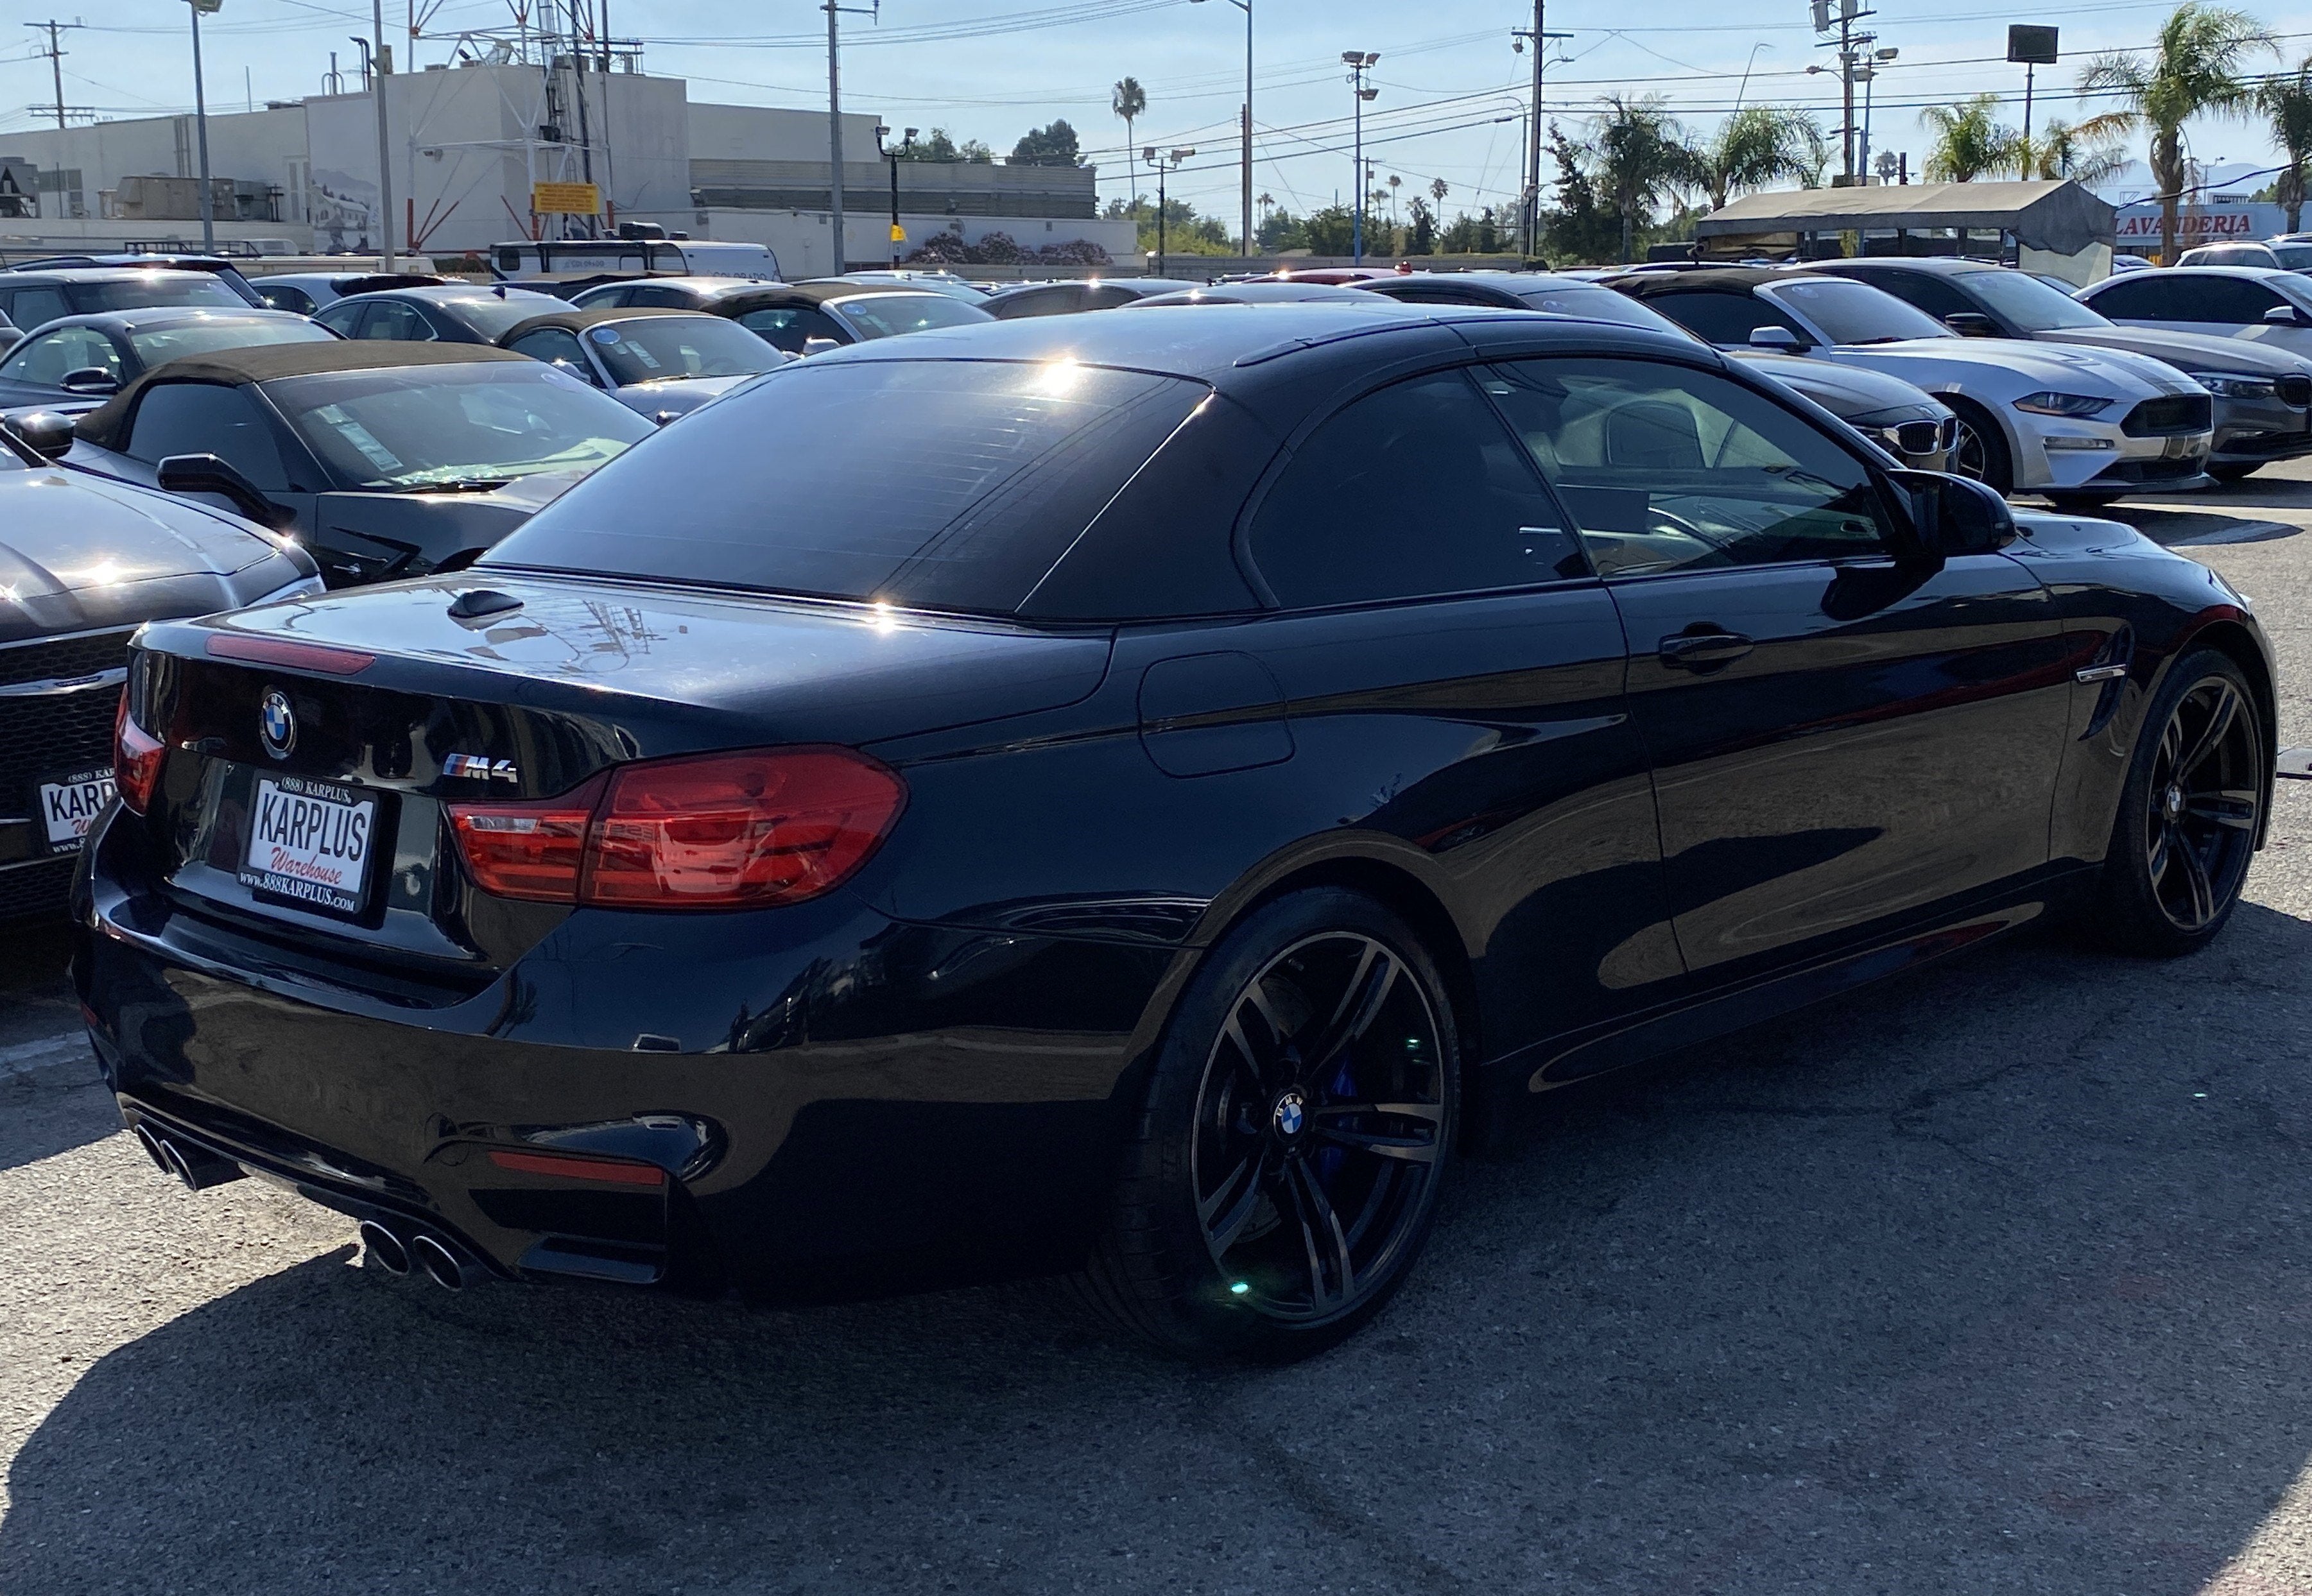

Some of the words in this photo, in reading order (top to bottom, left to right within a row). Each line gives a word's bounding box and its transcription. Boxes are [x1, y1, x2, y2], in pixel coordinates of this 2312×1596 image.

[2116, 215, 2250, 234] LAVADERIA
[463, 756, 517, 782] M4
[281, 777, 304, 791] (888)
[259, 793, 366, 861] KARPLUS
[271, 846, 343, 884] Warehouse
